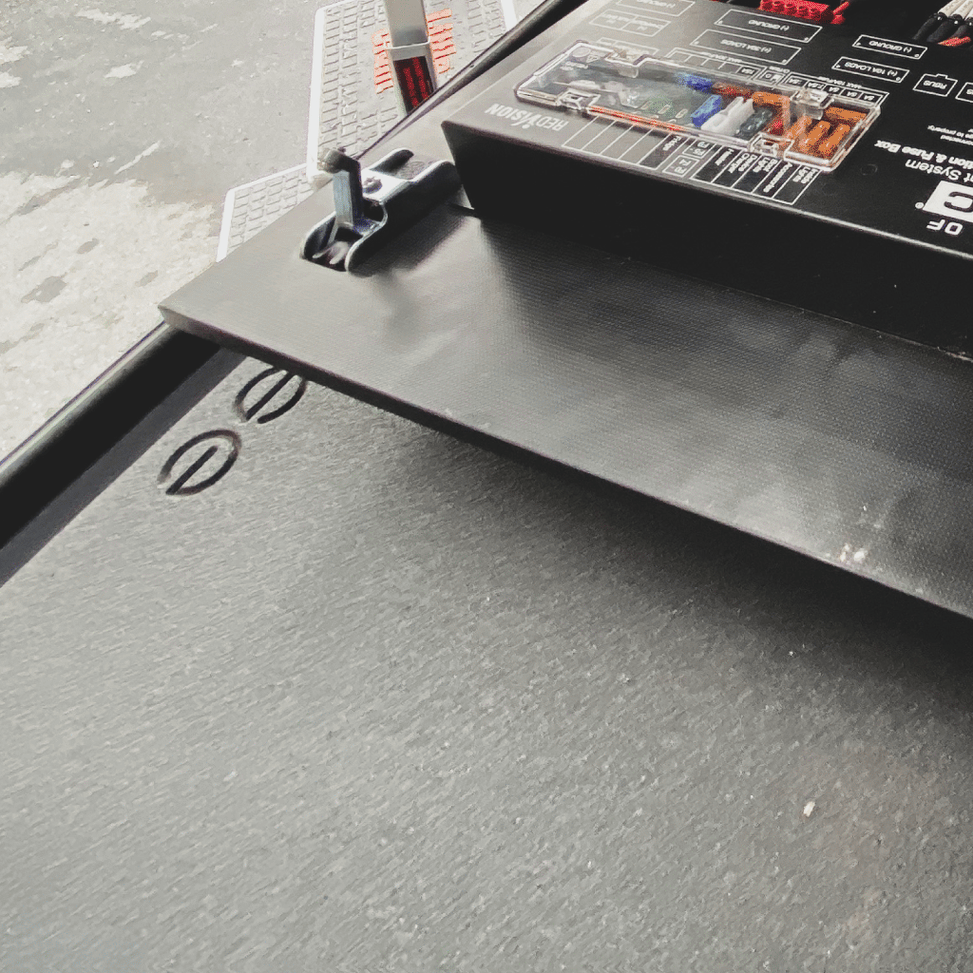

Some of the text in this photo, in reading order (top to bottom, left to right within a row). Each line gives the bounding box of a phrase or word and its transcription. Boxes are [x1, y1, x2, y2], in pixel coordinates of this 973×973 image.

[747, 19, 780, 29] GROUND
[720, 38, 746, 47] LOADS
[868, 40, 902, 51] GROUND
[844, 61, 871, 71] LOADS
[923, 79, 947, 89] RBUS
[483, 103, 568, 131] REDVISION
[662, 135, 683, 151] Fridge
[873, 139, 901, 152] Box
[901, 146, 934, 160] Fuse
[935, 153, 947, 163] &
[727, 152, 750, 173] Charger
[752, 156, 770, 172] Lights
[904, 158, 961, 180] System
[762, 161, 795, 192] Accessories
[792, 165, 810, 182] Lights
[926, 218, 962, 235] OF
